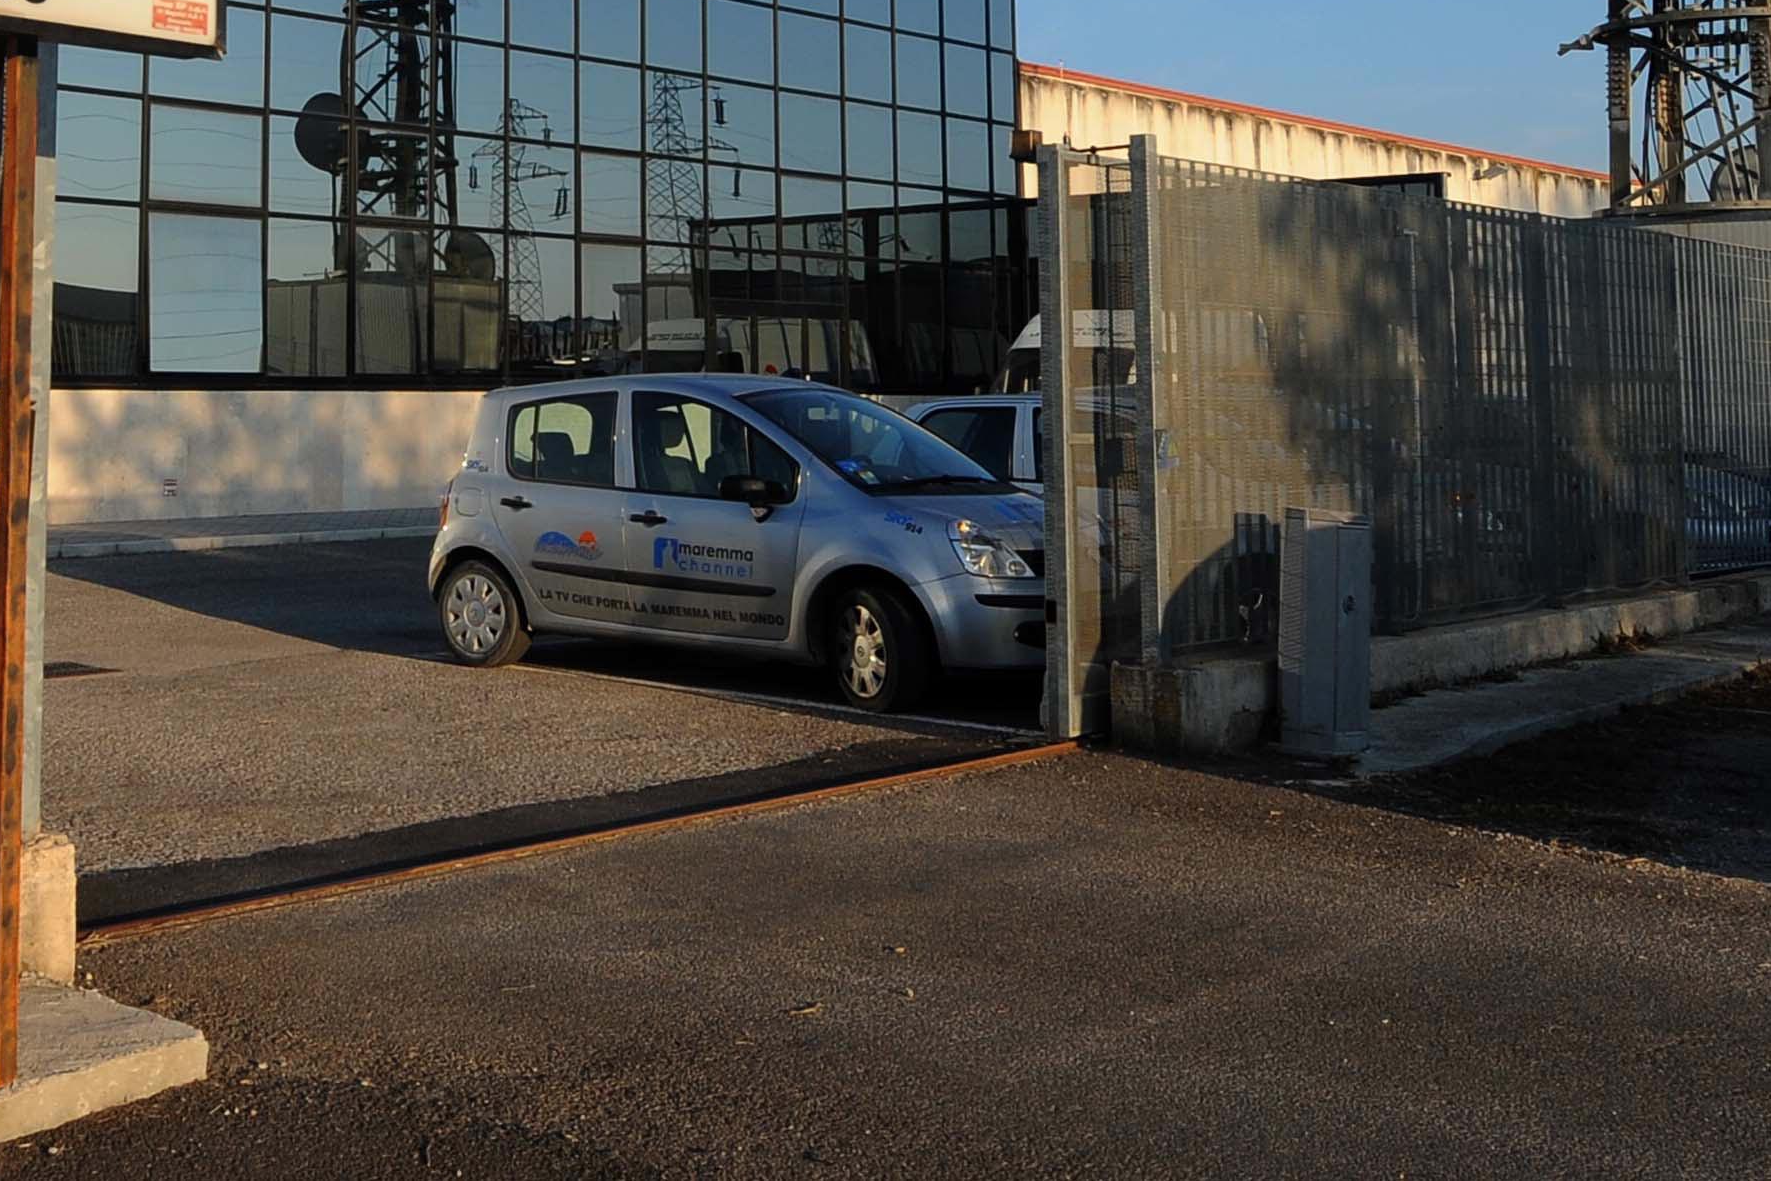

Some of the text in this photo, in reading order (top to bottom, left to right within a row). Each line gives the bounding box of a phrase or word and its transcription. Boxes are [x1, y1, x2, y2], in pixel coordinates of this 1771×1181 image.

[678, 542, 754, 562] maremma
[678, 558, 754, 579] channel
[539, 588, 785, 627] LA TV CHE PORTA LA MAREMMA NEL MONDO
